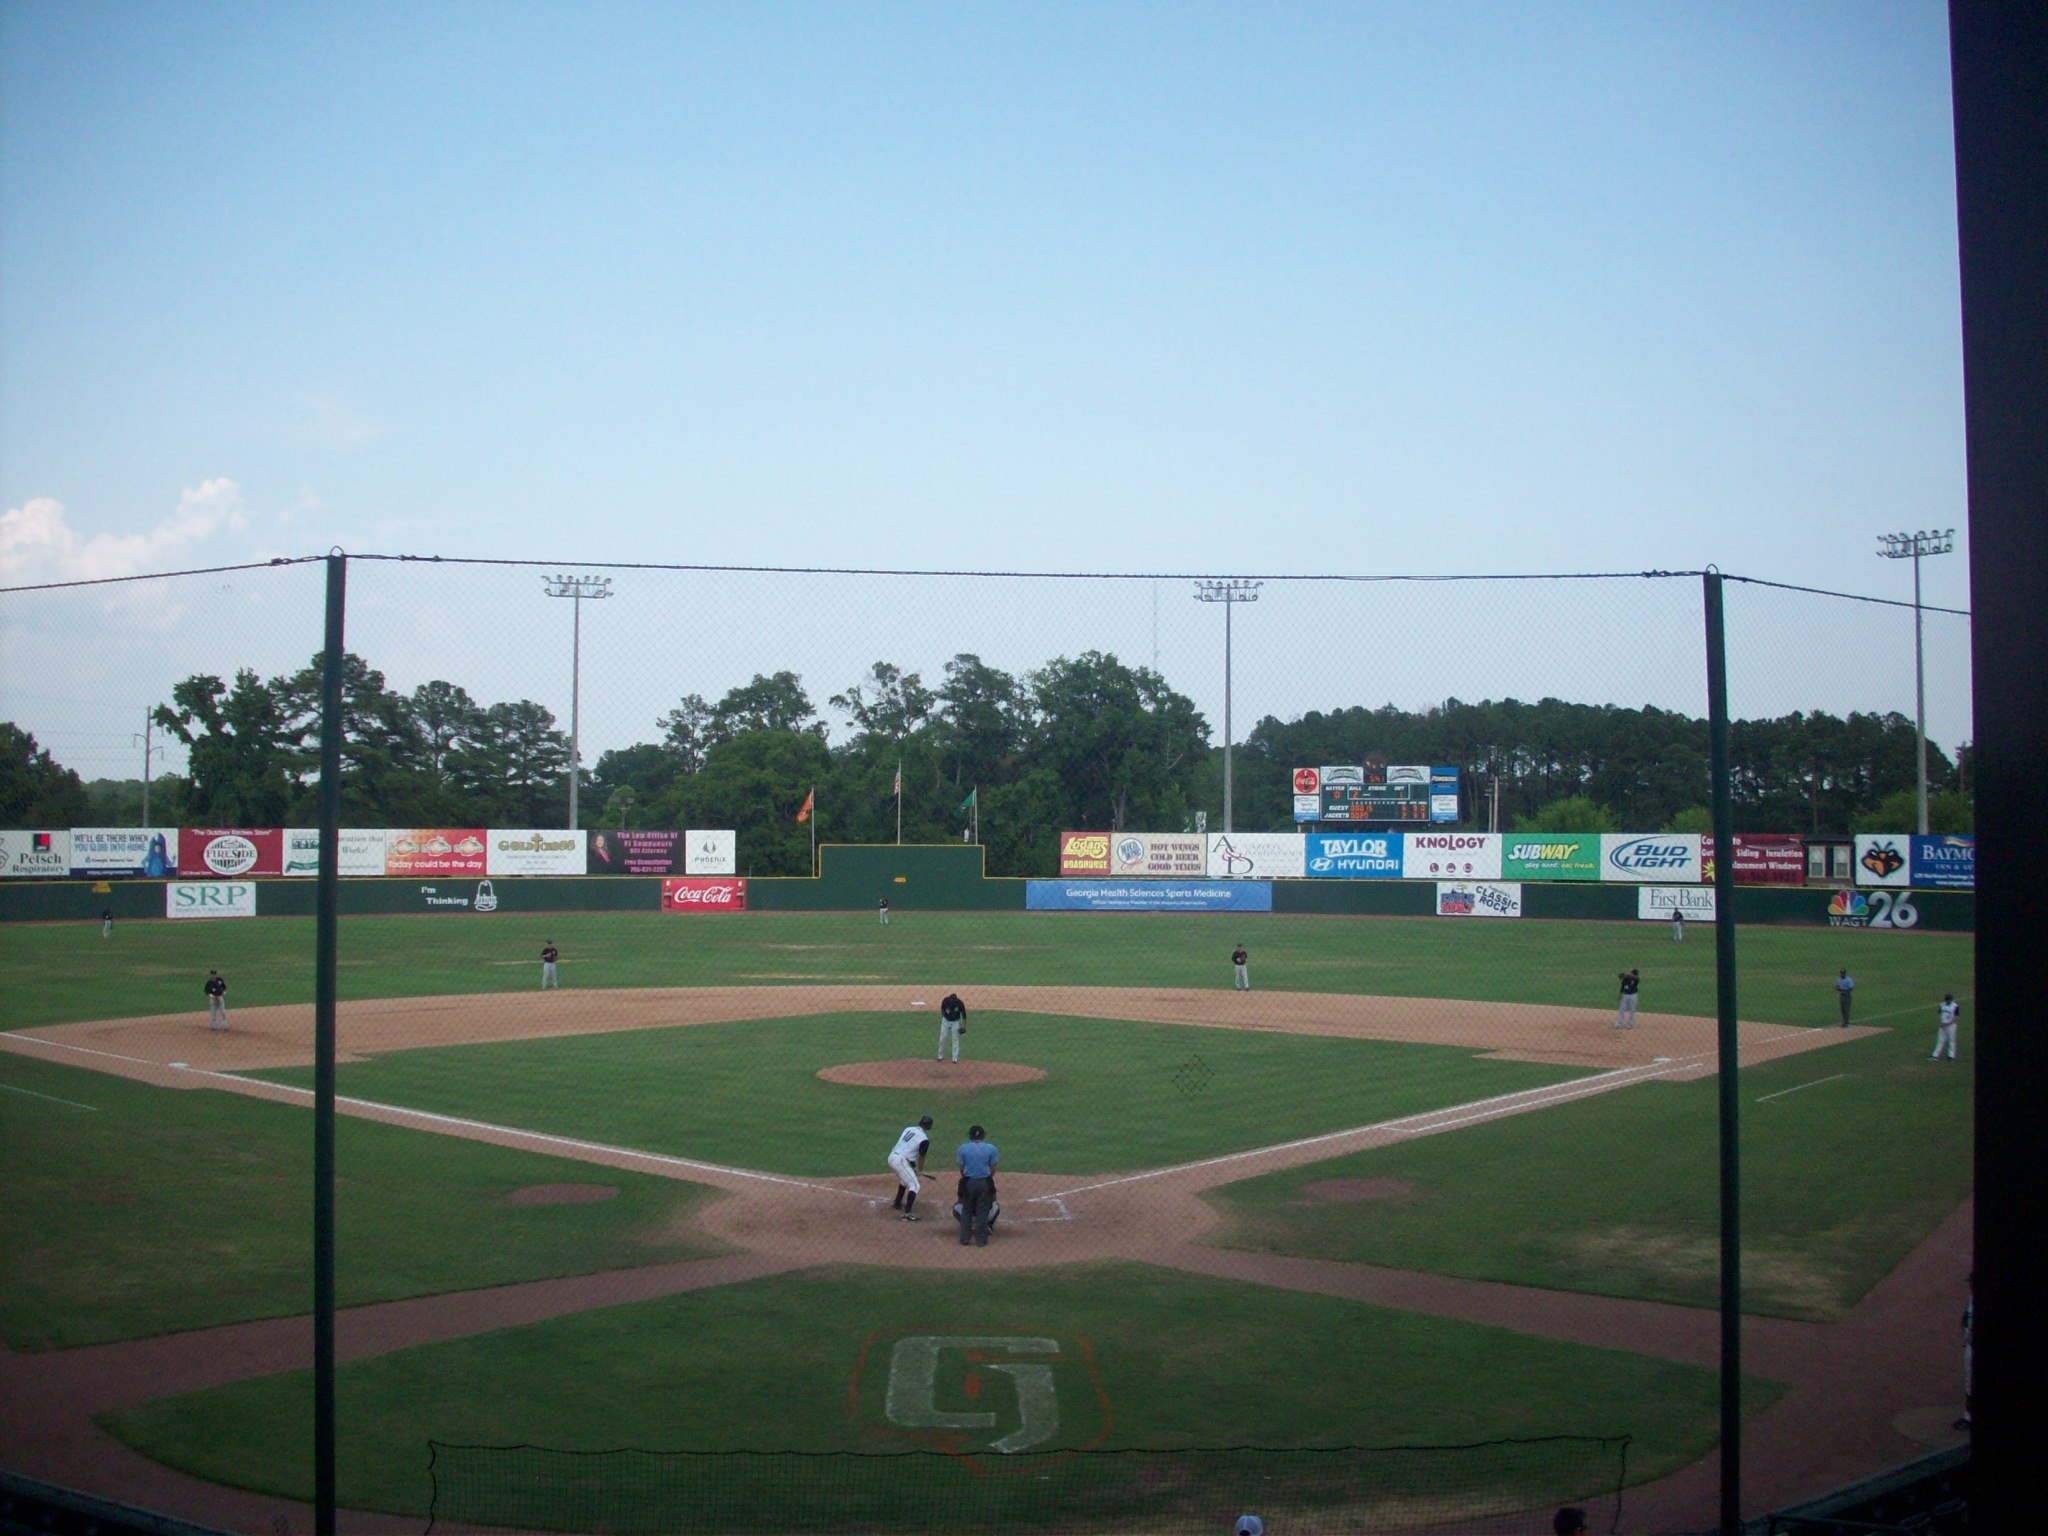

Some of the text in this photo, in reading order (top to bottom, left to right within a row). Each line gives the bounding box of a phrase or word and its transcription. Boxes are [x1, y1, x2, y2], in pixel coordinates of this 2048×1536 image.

[106, 834, 128, 843] THERE
[129, 834, 149, 843] WHEN
[631, 831, 646, 839] Law
[1150, 843, 1200, 851] HOT WINGS
[1320, 840, 1387, 855] TAYLOR
[1415, 835, 1486, 851] KNOLOGY
[206, 849, 257, 859] FIRESIDE
[1507, 843, 1580, 860] SUBWAY
[1633, 844, 1687, 856] BUD
[20, 852, 62, 864] Petsch
[1150, 853, 1199, 861] COLD BEER
[1621, 857, 1692, 868] LIGHT
[12, 864, 64, 875] Respiratory
[466, 861, 483, 869] day
[1063, 860, 1107, 869] ROADHOUSE
[1147, 863, 1201, 871] GOOD TIMES
[1337, 859, 1399, 870] HYUNDAI
[1767, 861, 1802, 870] Windows
[176, 885, 248, 906] SRP
[674, 885, 734, 903] Coca-Cola
[1066, 888, 1232, 899] Georgia Health Sciences Sports Medicine
[1475, 885, 1519, 910] CLASSIC
[1650, 888, 1714, 908] First Bank
[426, 896, 469, 906] Thinking
[1478, 896, 1508, 914] ROCK
[1868, 890, 1919, 929] 26
[1829, 916, 1869, 927] WAGT
